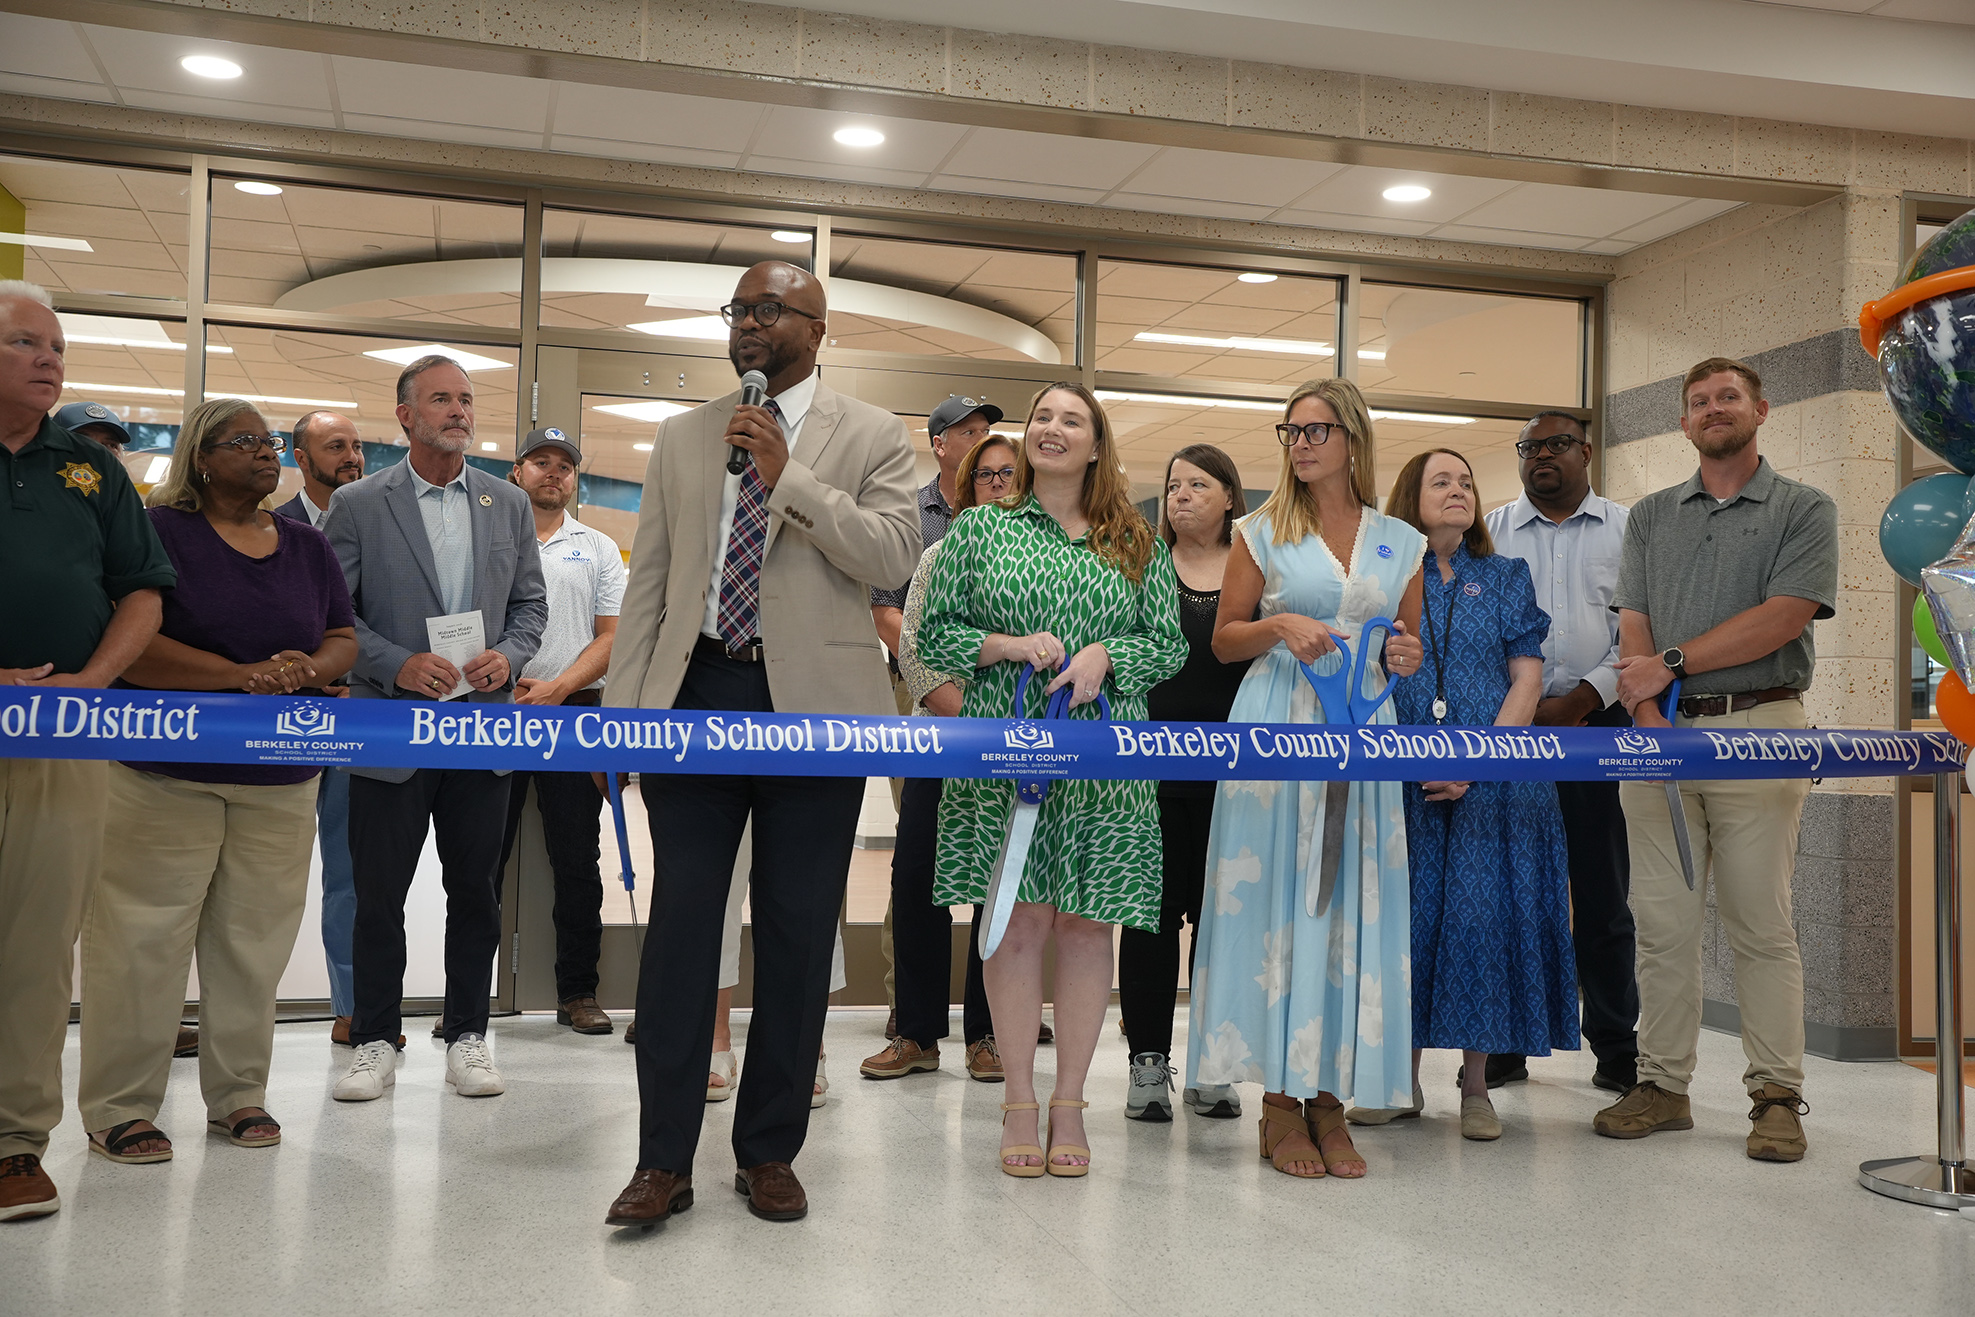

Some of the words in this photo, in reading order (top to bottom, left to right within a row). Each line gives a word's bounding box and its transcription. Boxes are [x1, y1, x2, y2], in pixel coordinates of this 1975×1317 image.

[0, 695, 42, 738] ol
[52, 696, 200, 741] District
[409, 707, 565, 760] Berkeley
[574, 712, 696, 763] County
[706, 716, 816, 752] School
[822, 719, 944, 755] District
[245, 740, 309, 749] BERKELEY
[311, 742, 364, 750] COUNTY
[981, 753, 1034, 761] BERKELEY
[1035, 754, 1080, 762] COUNTY
[1109, 725, 1241, 770] Berkeley
[1249, 727, 1350, 770] County
[1357, 729, 1458, 759] School
[1454, 729, 1566, 760] District
[1598, 758, 1644, 766] BERKELEY
[1645, 758, 1683, 766] COUNTY
[1701, 731, 1823, 771] Berkeley
[1826, 732, 1921, 771] County
[1922, 732, 1966, 768] Sch
